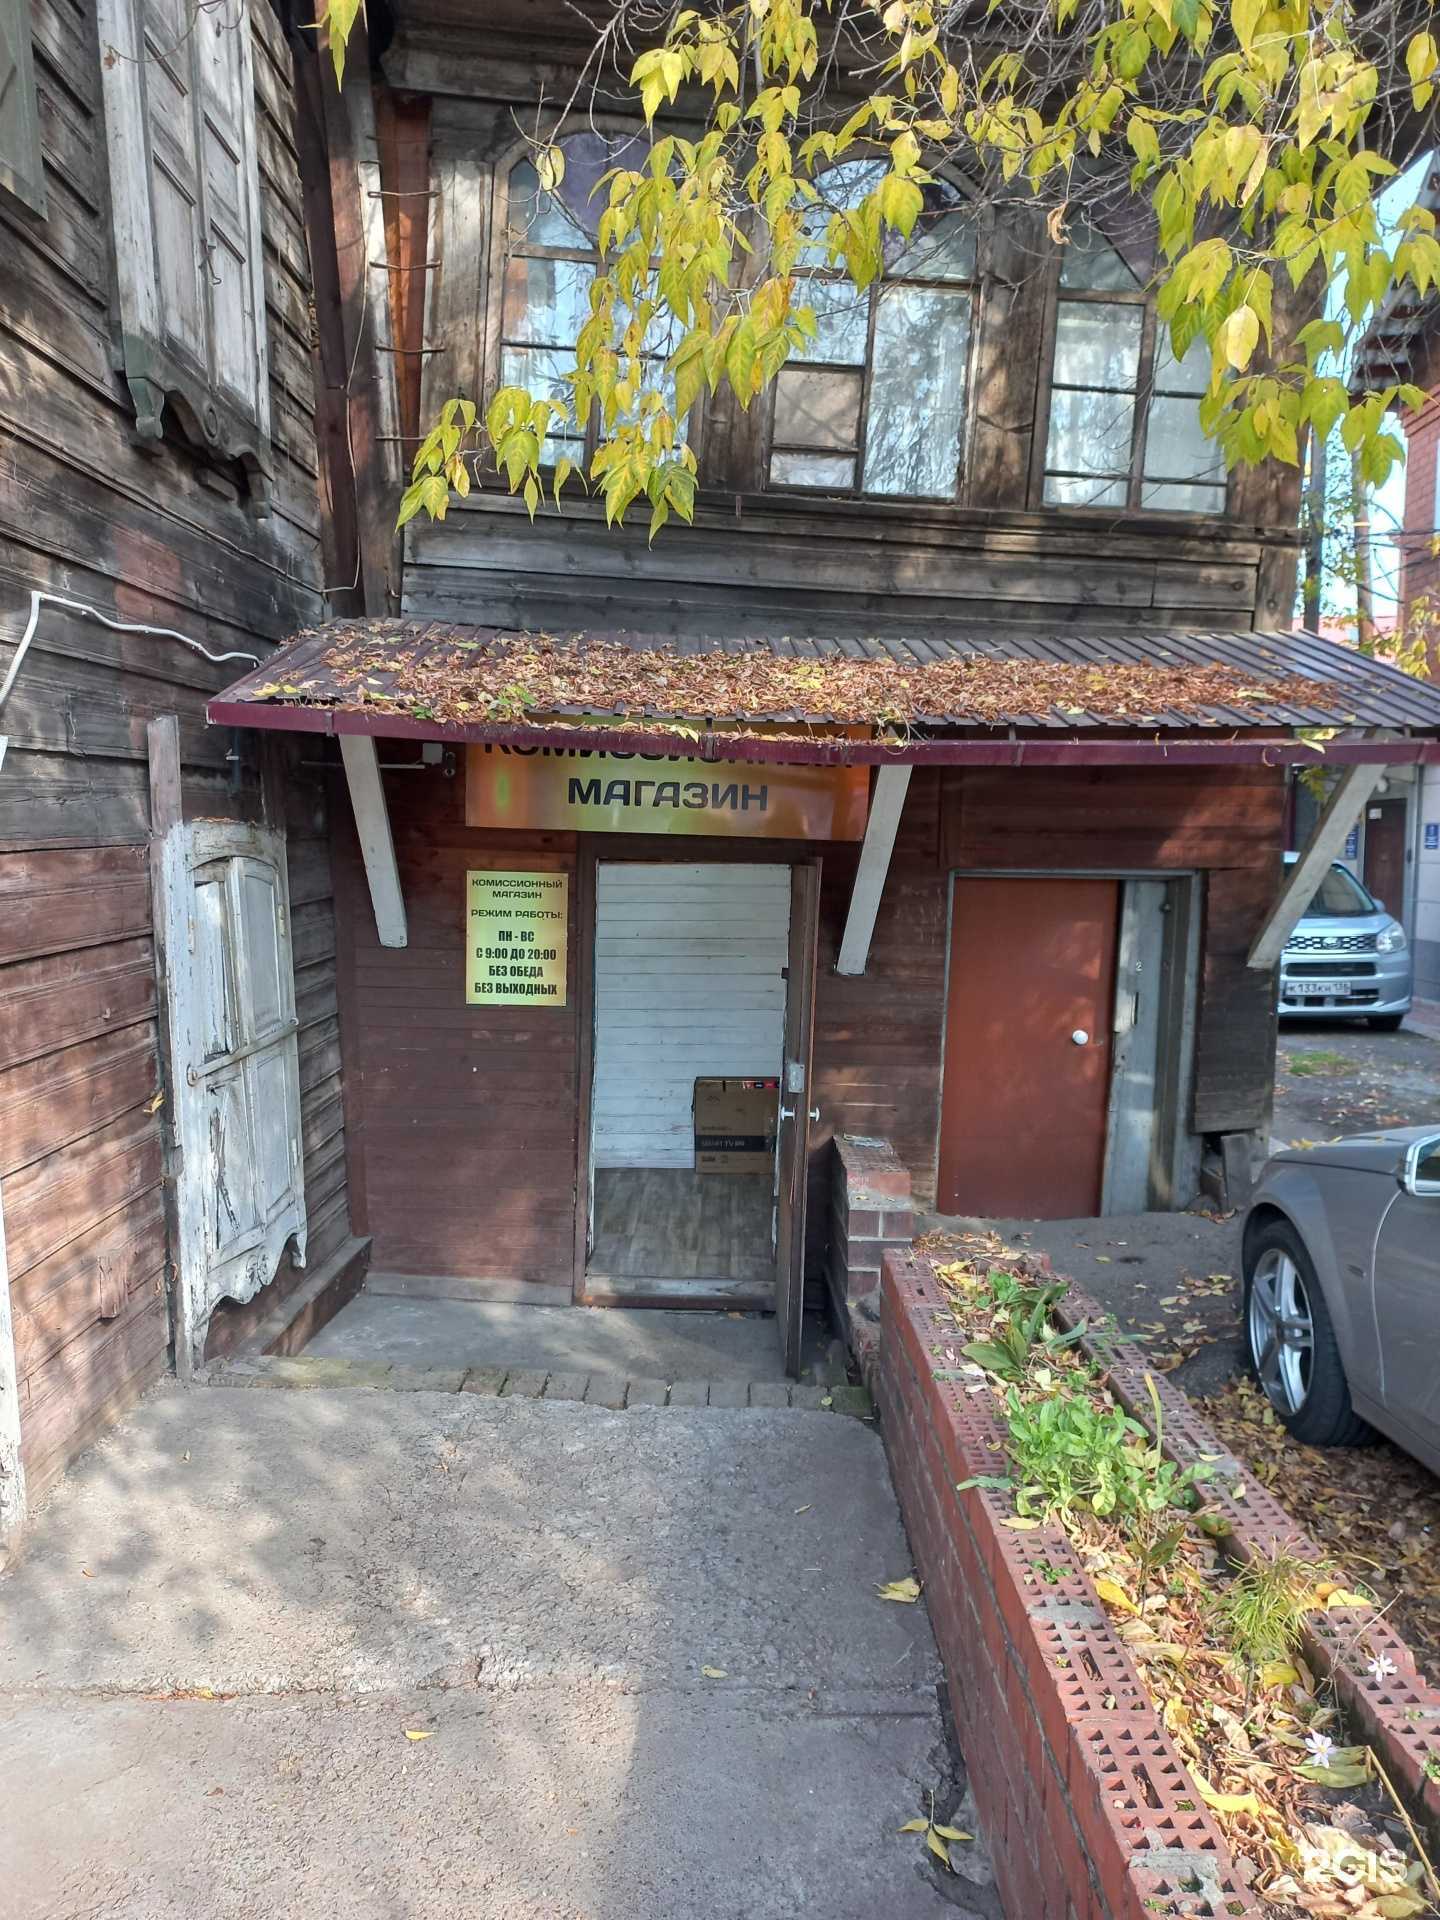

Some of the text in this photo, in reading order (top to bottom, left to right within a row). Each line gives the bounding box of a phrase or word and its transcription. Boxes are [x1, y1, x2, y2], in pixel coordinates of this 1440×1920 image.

[568, 777, 768, 812] МАГАЗИН
[472, 879, 563, 889] КОМИССИОННЫЙ
[492, 890, 542, 899] МАГАЗИН
[471, 909, 563, 919] РЕЖИМ РАБОТЫ:
[498, 930, 512, 942] ПН
[520, 931, 535, 942] ВС
[476, 947, 557, 961] С 9:00 ДО 20:00
[488, 965, 544, 978] БЕЗ ОБЕДА
[474, 982, 557, 996] БЕЗ ВЫХОДНЫХ
